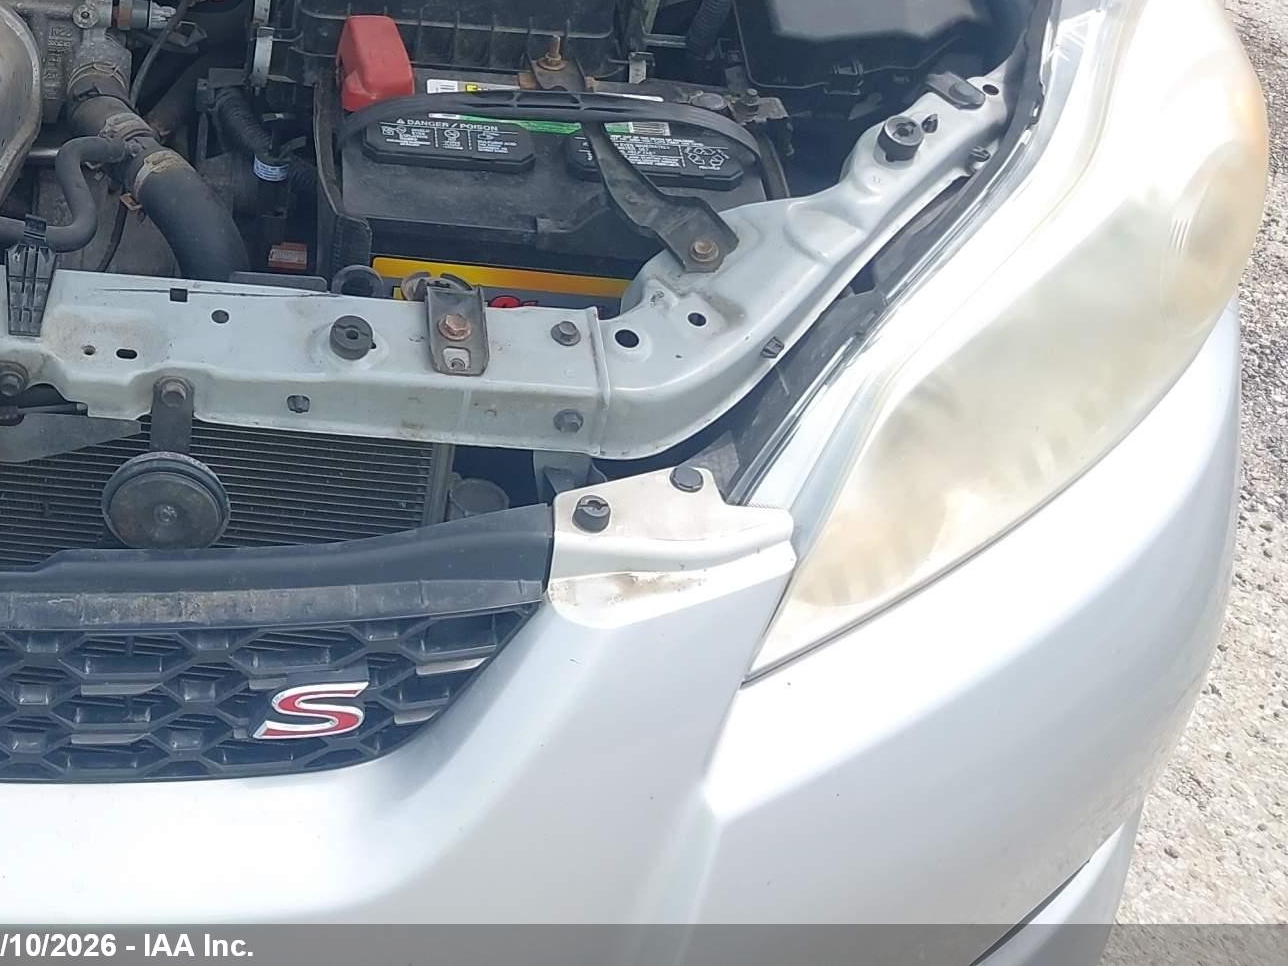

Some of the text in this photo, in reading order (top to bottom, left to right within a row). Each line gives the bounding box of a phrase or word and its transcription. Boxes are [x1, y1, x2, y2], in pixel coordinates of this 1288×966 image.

[406, 119, 450, 129] DANGER
[459, 122, 499, 132] POISON
[252, 681, 369, 740] S
